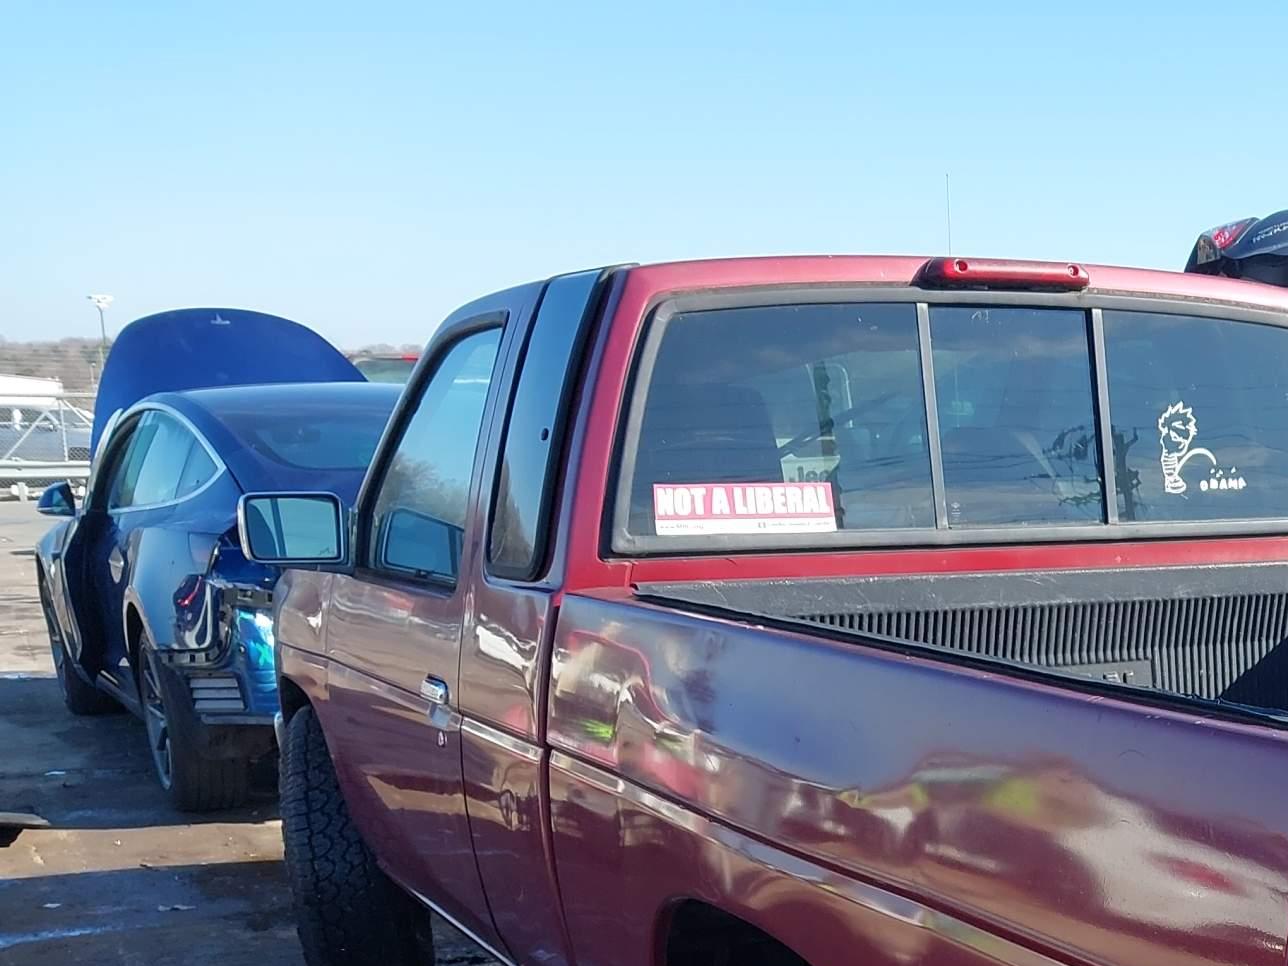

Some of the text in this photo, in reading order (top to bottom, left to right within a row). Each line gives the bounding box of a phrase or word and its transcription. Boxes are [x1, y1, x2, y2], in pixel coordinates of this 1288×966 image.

[656, 486, 831, 516] NOT A LIBERAL
